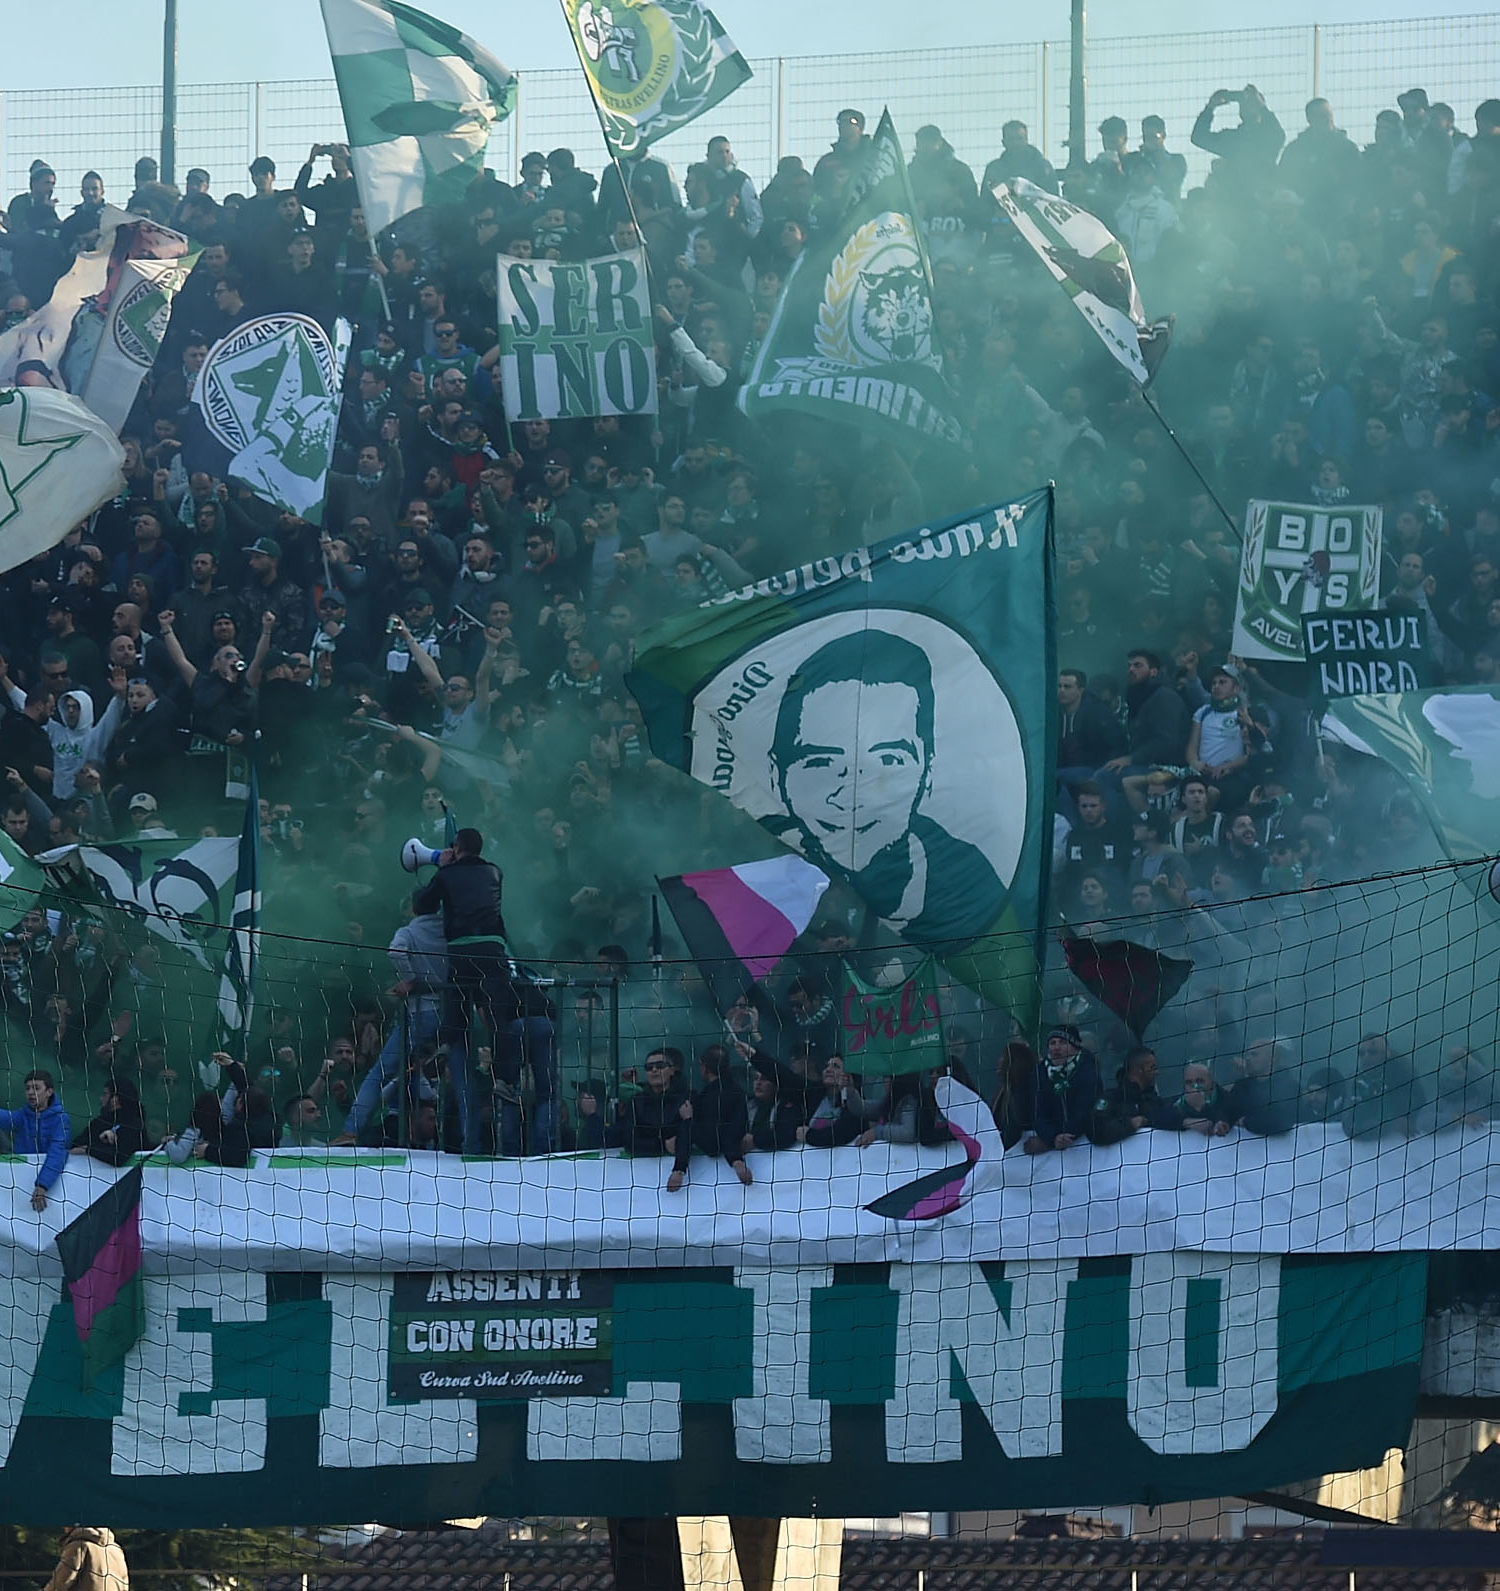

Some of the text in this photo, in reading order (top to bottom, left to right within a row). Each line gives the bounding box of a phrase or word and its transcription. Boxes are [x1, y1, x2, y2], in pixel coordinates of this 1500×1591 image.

[507, 257, 644, 339] SER
[515, 336, 650, 421] INO
[843, 979, 940, 1052] Girls
[426, 1269, 581, 1302] ASSENTI
[407, 1317, 599, 1353] CON ONORE
[419, 1369, 584, 1388] Curva Sud Avellino
